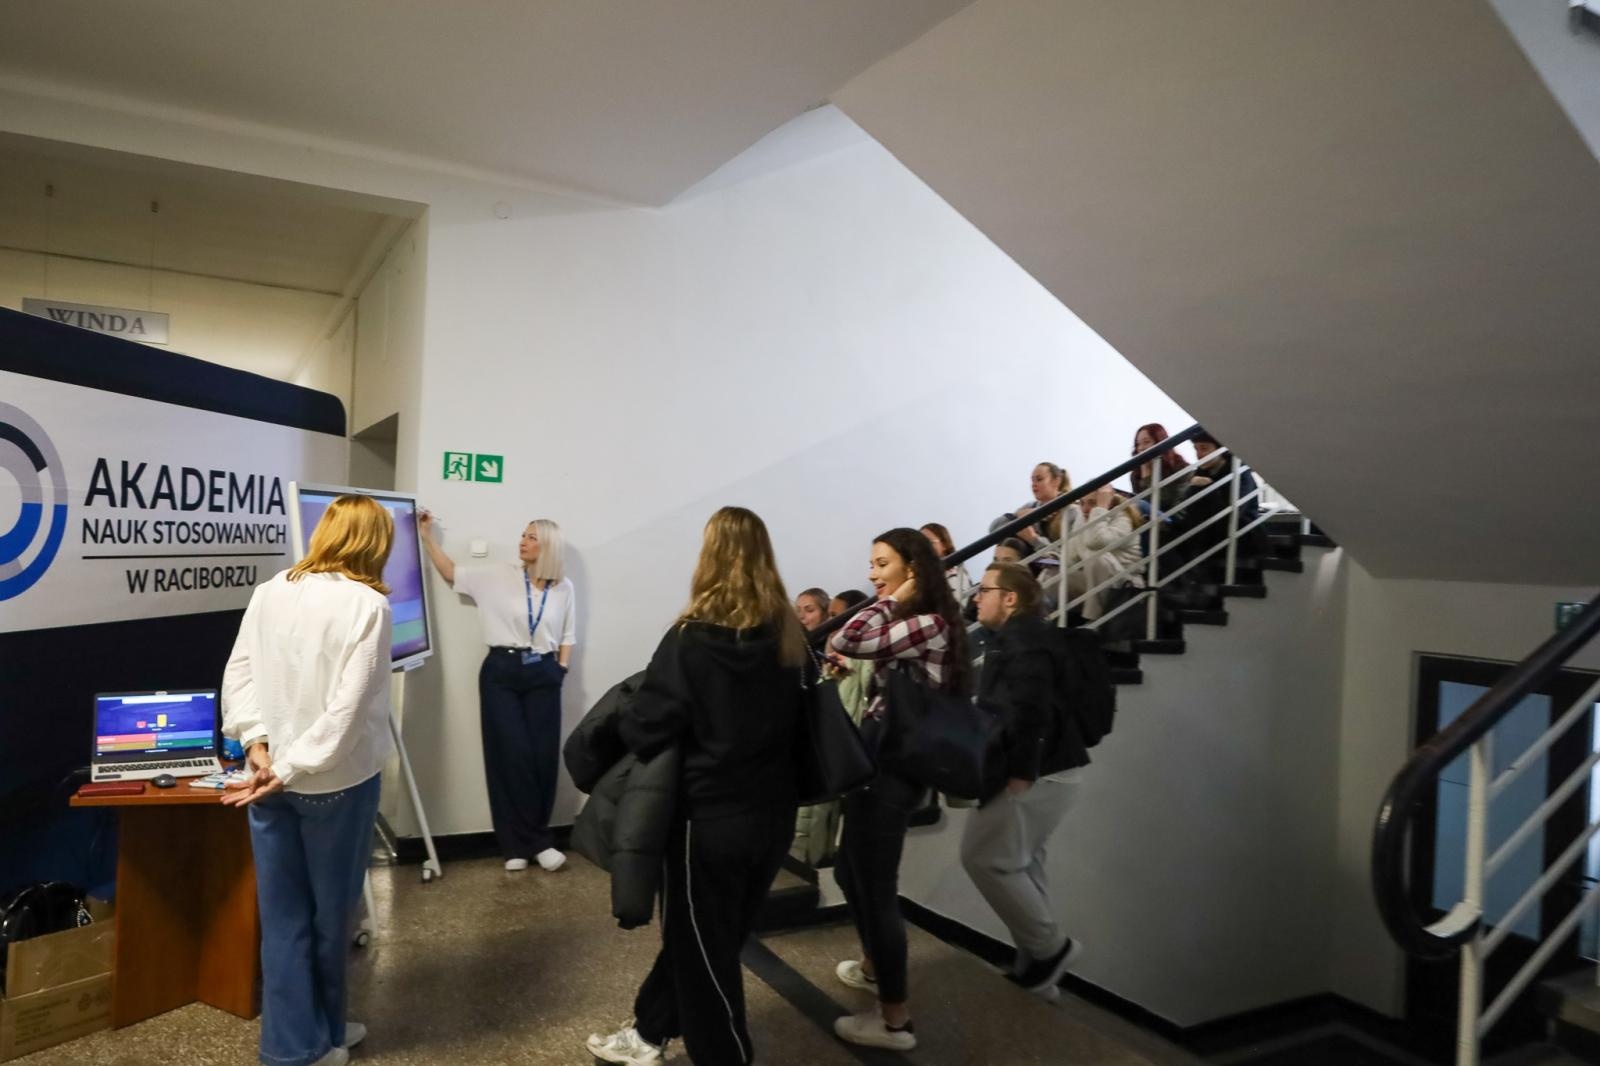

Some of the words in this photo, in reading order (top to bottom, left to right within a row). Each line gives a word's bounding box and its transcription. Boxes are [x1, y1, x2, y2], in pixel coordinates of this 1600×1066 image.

[46, 307, 146, 335] WINDA
[84, 457, 285, 515] AKADEMIA
[82, 518, 148, 544] NAUK
[153, 520, 285, 544] STOSOWANYCH
[126, 569, 149, 594] W
[154, 565, 257, 592] RACIBORZU
